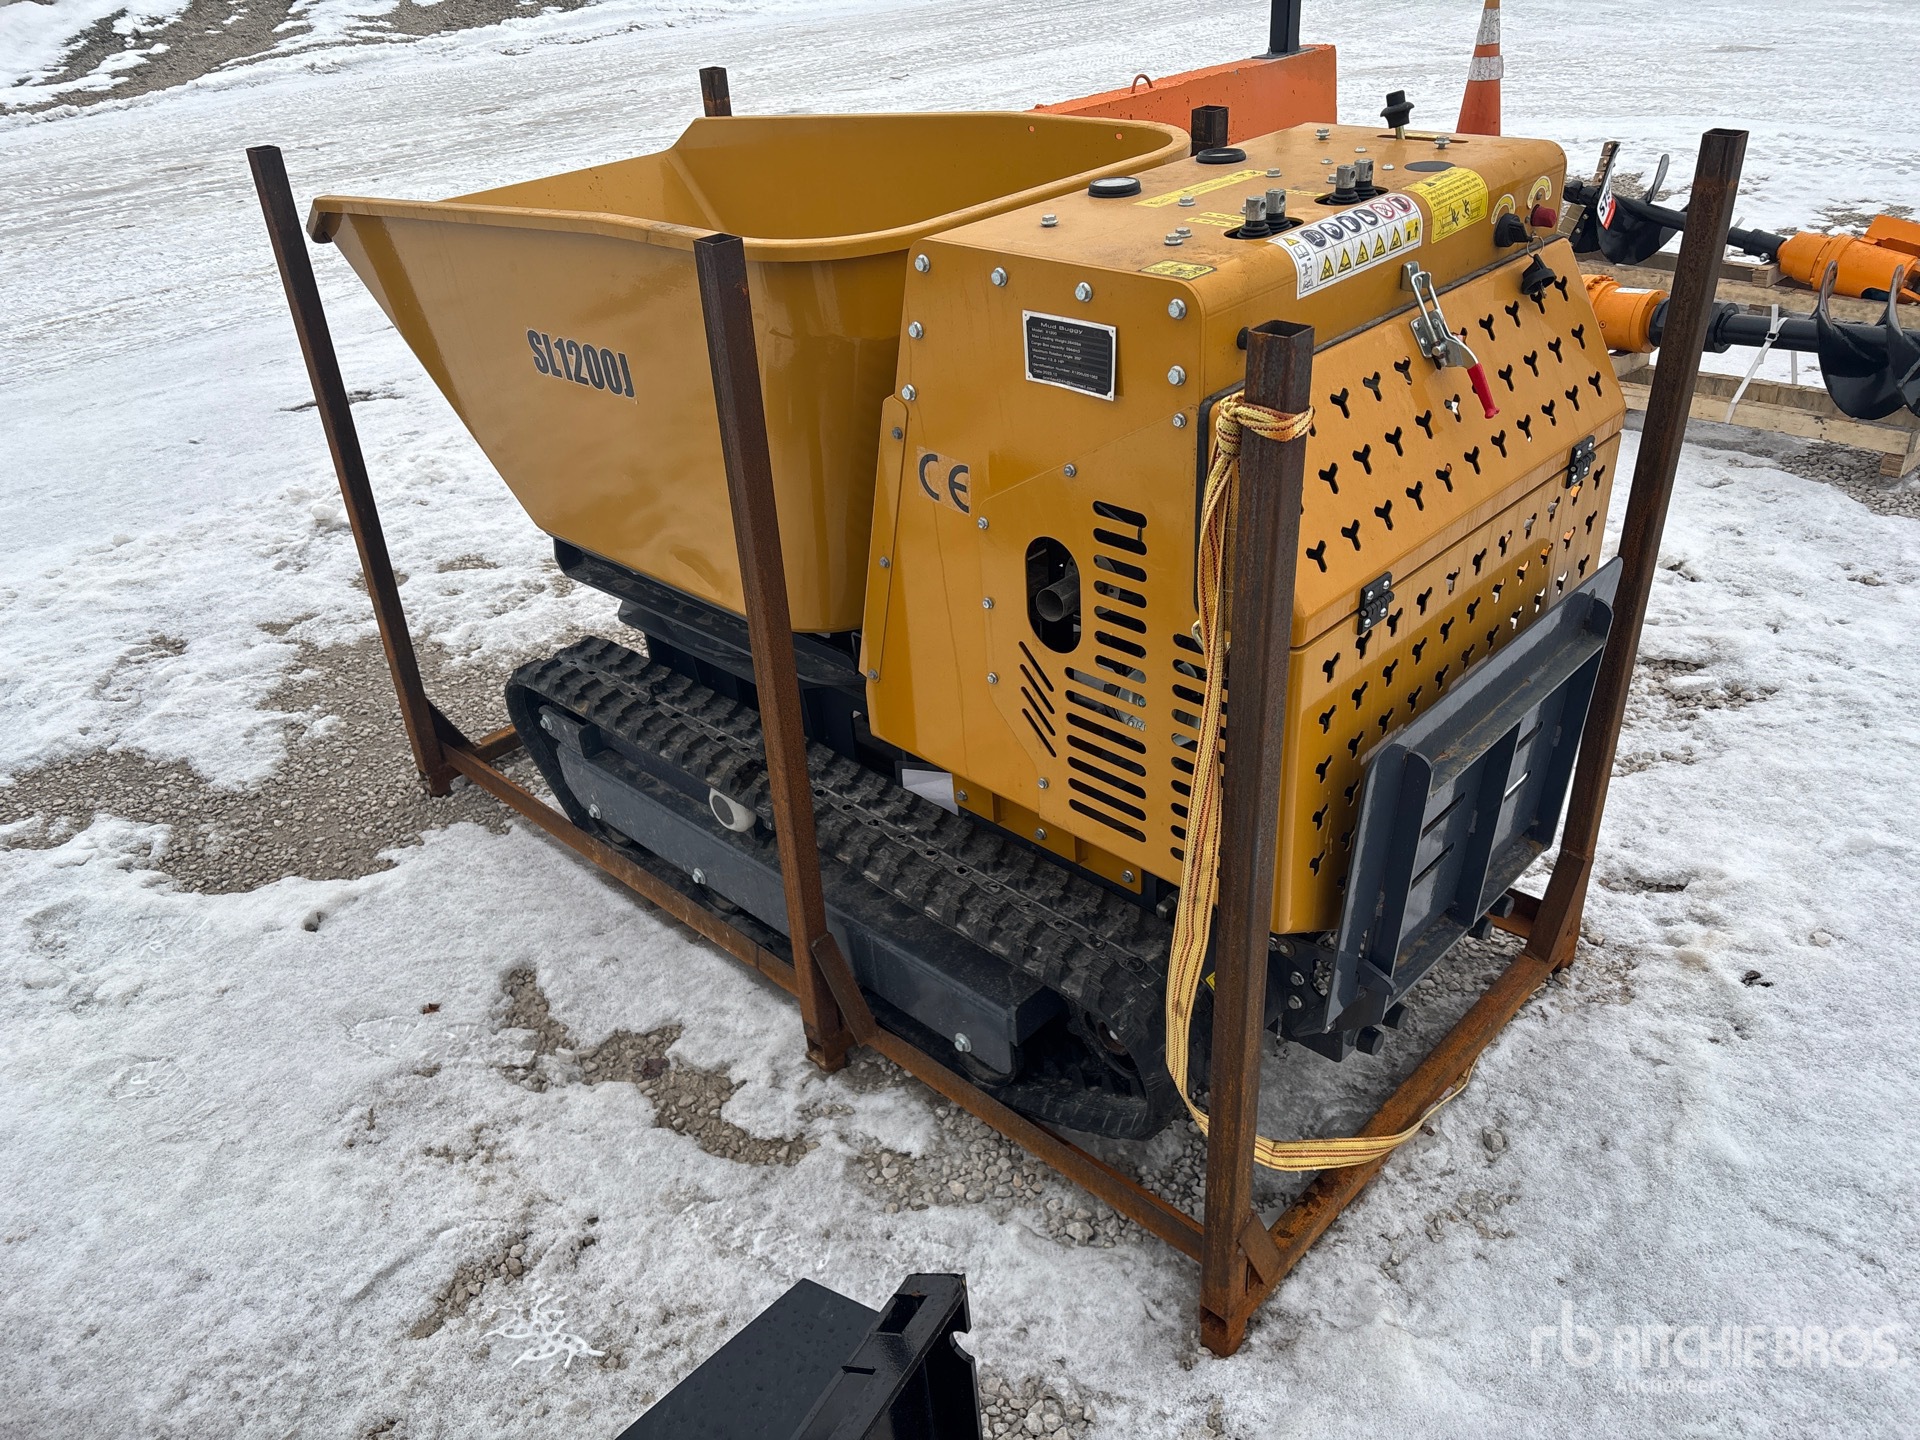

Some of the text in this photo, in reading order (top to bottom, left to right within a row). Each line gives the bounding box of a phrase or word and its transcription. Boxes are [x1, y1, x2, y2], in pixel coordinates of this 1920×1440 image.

[1040, 322, 1083, 334] Mud Buggy
[526, 328, 636, 399] SL1200J
[918, 452, 970, 514] CE
